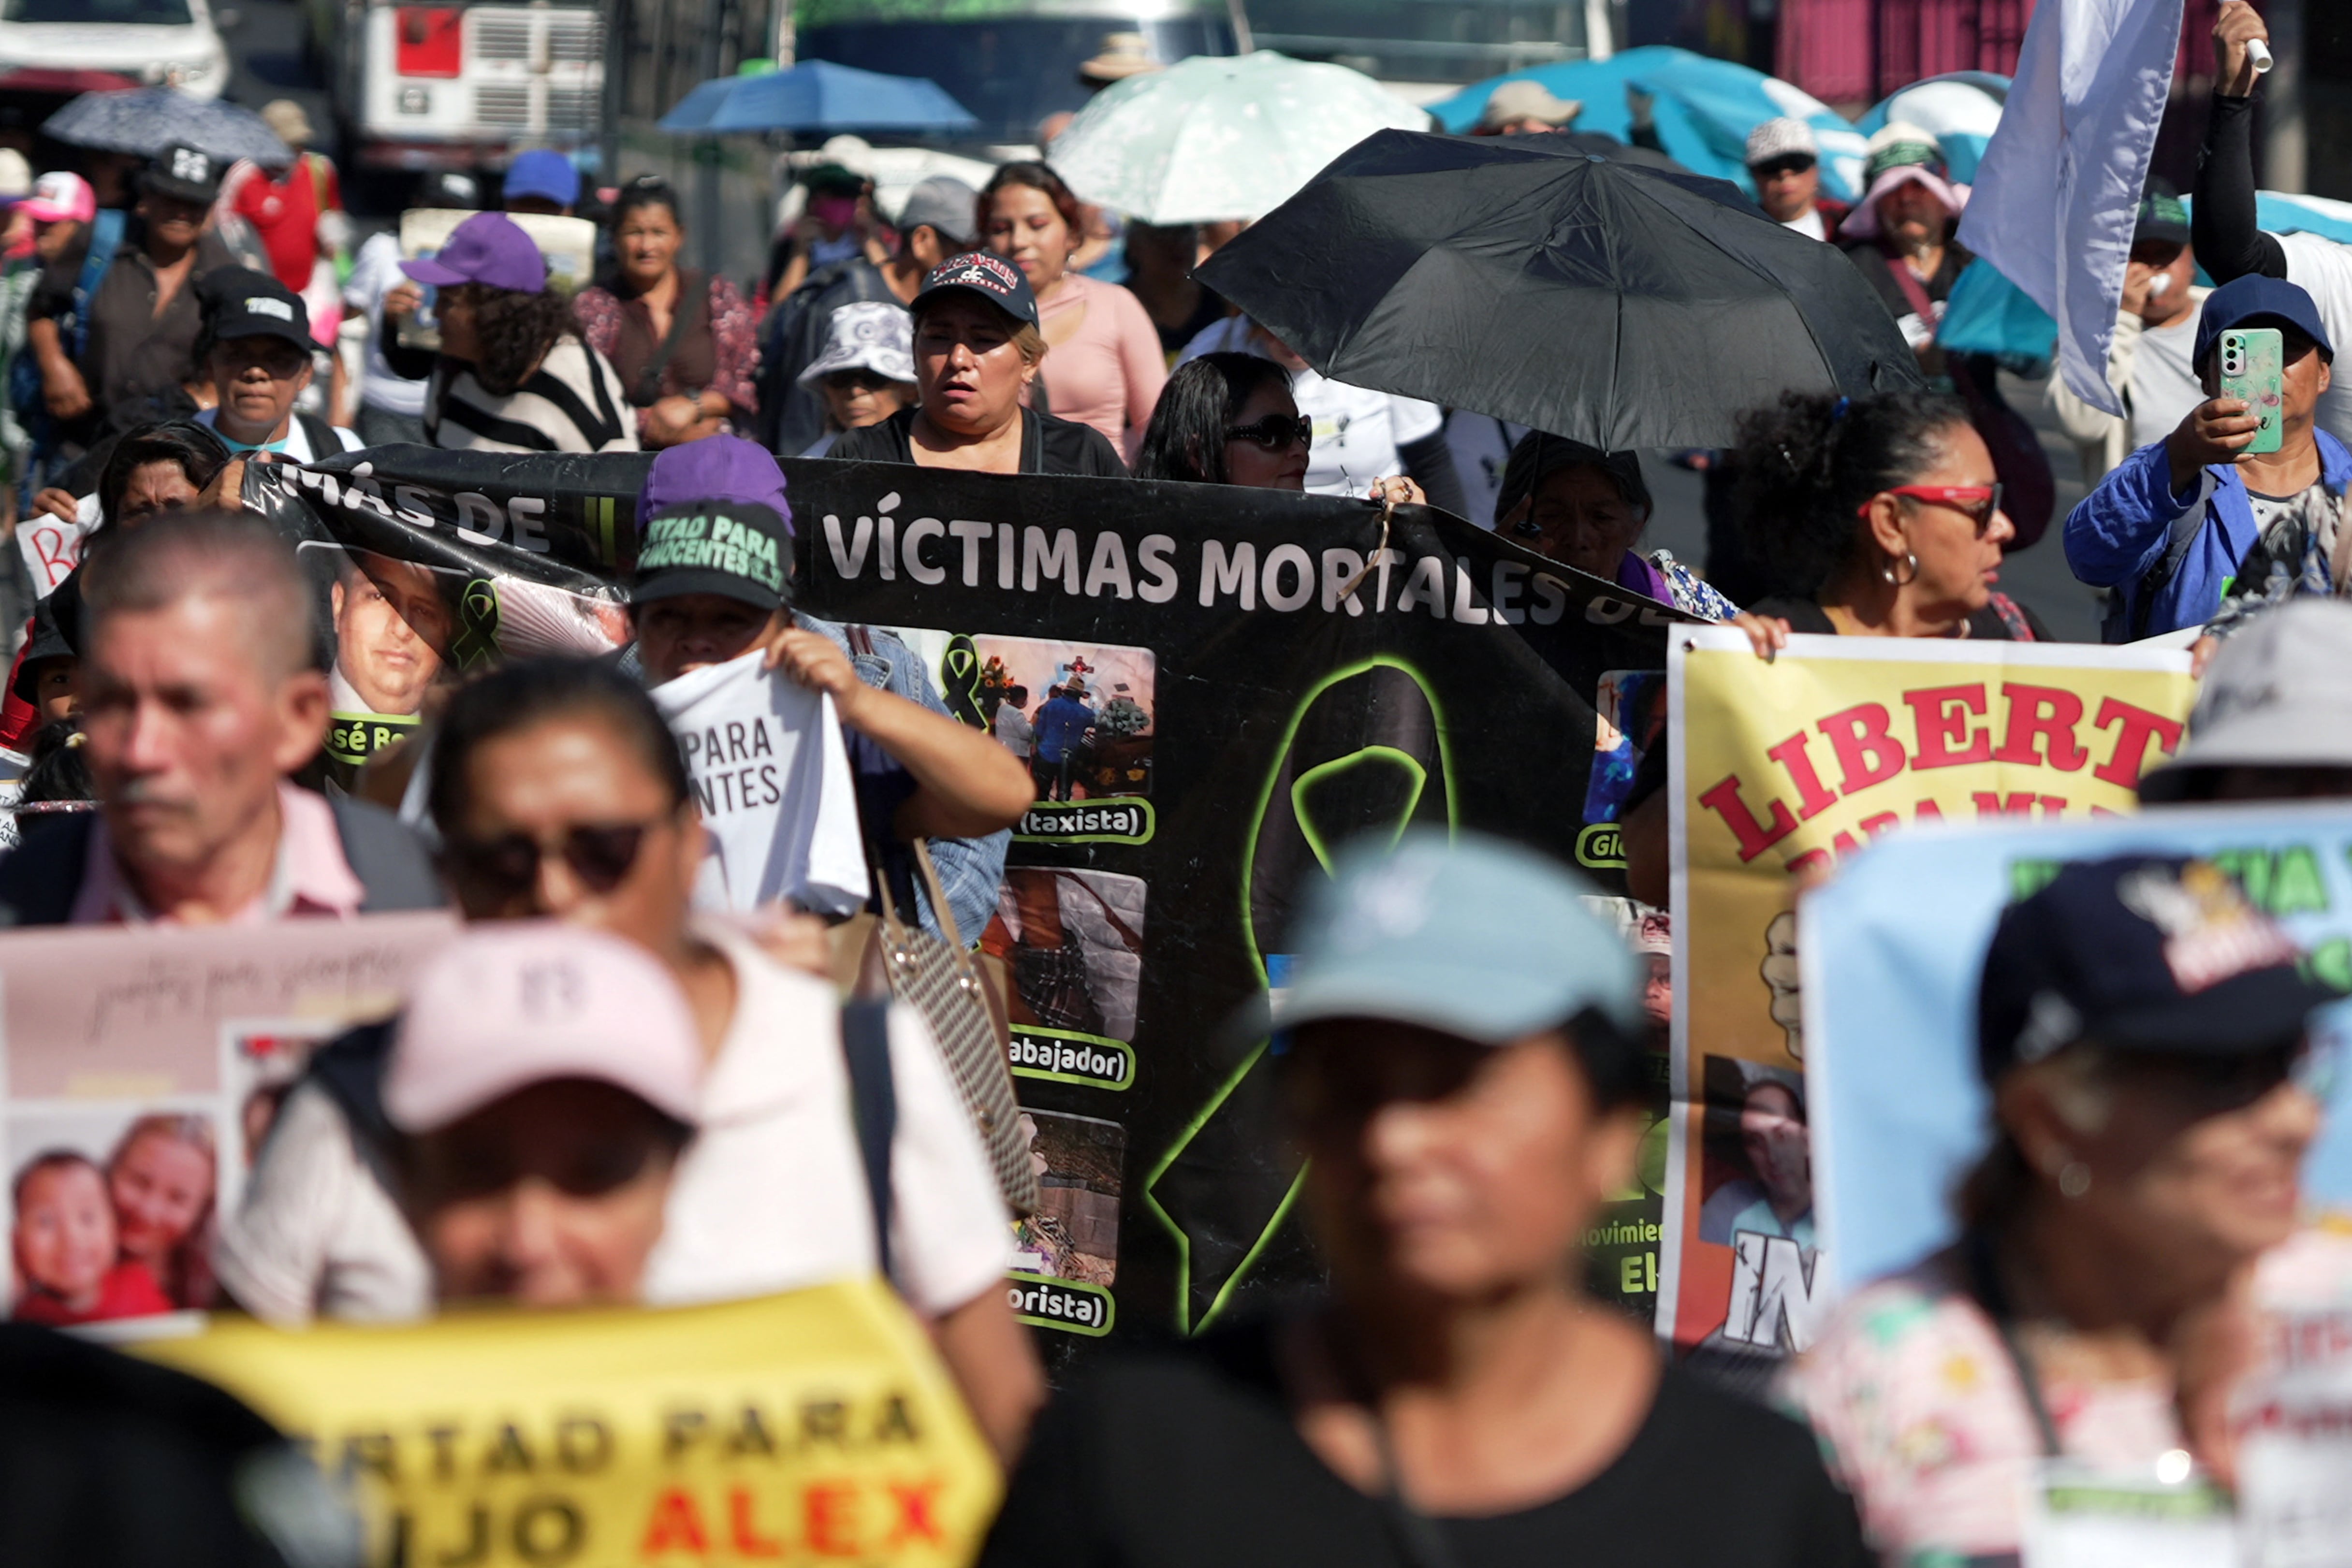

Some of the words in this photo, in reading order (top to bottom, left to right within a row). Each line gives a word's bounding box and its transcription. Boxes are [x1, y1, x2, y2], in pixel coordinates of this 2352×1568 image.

[453, 491, 550, 553] DE
[823, 491, 1178, 604] VÍCTIMAS
[1198, 539, 1570, 625] MORTALES
[712, 515, 778, 566] PARA
[679, 717, 773, 769] PARA
[1020, 808, 1139, 836] (taxista)
[663, 1395, 919, 1465] PARA
[641, 1483, 943, 1559] ALEX
